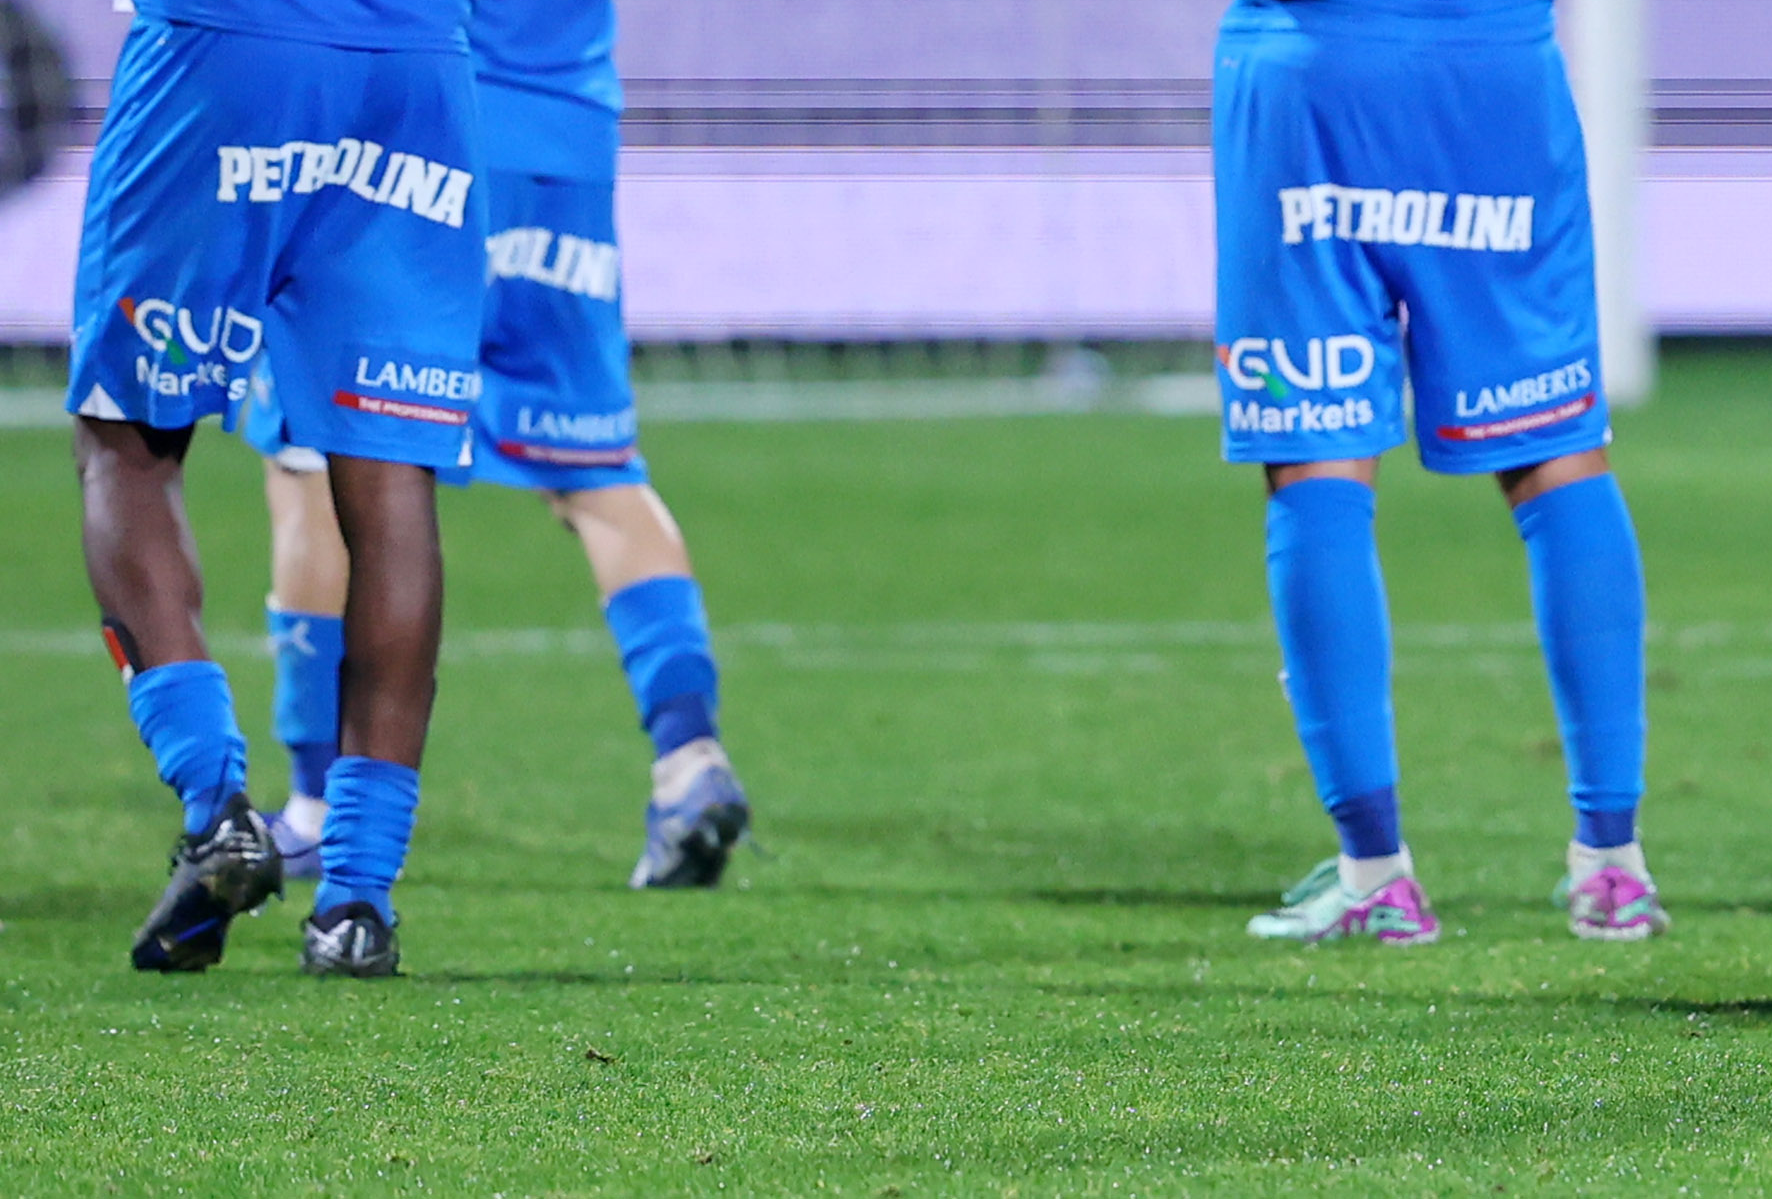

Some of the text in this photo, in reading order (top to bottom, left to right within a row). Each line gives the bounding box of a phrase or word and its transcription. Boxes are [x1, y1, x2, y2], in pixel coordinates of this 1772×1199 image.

[217, 138, 472, 228] PETROLINA
[1279, 183, 1535, 252] PETROLINA
[1229, 397, 1373, 433] Markets
[1456, 357, 1592, 417] LAMBERTS
